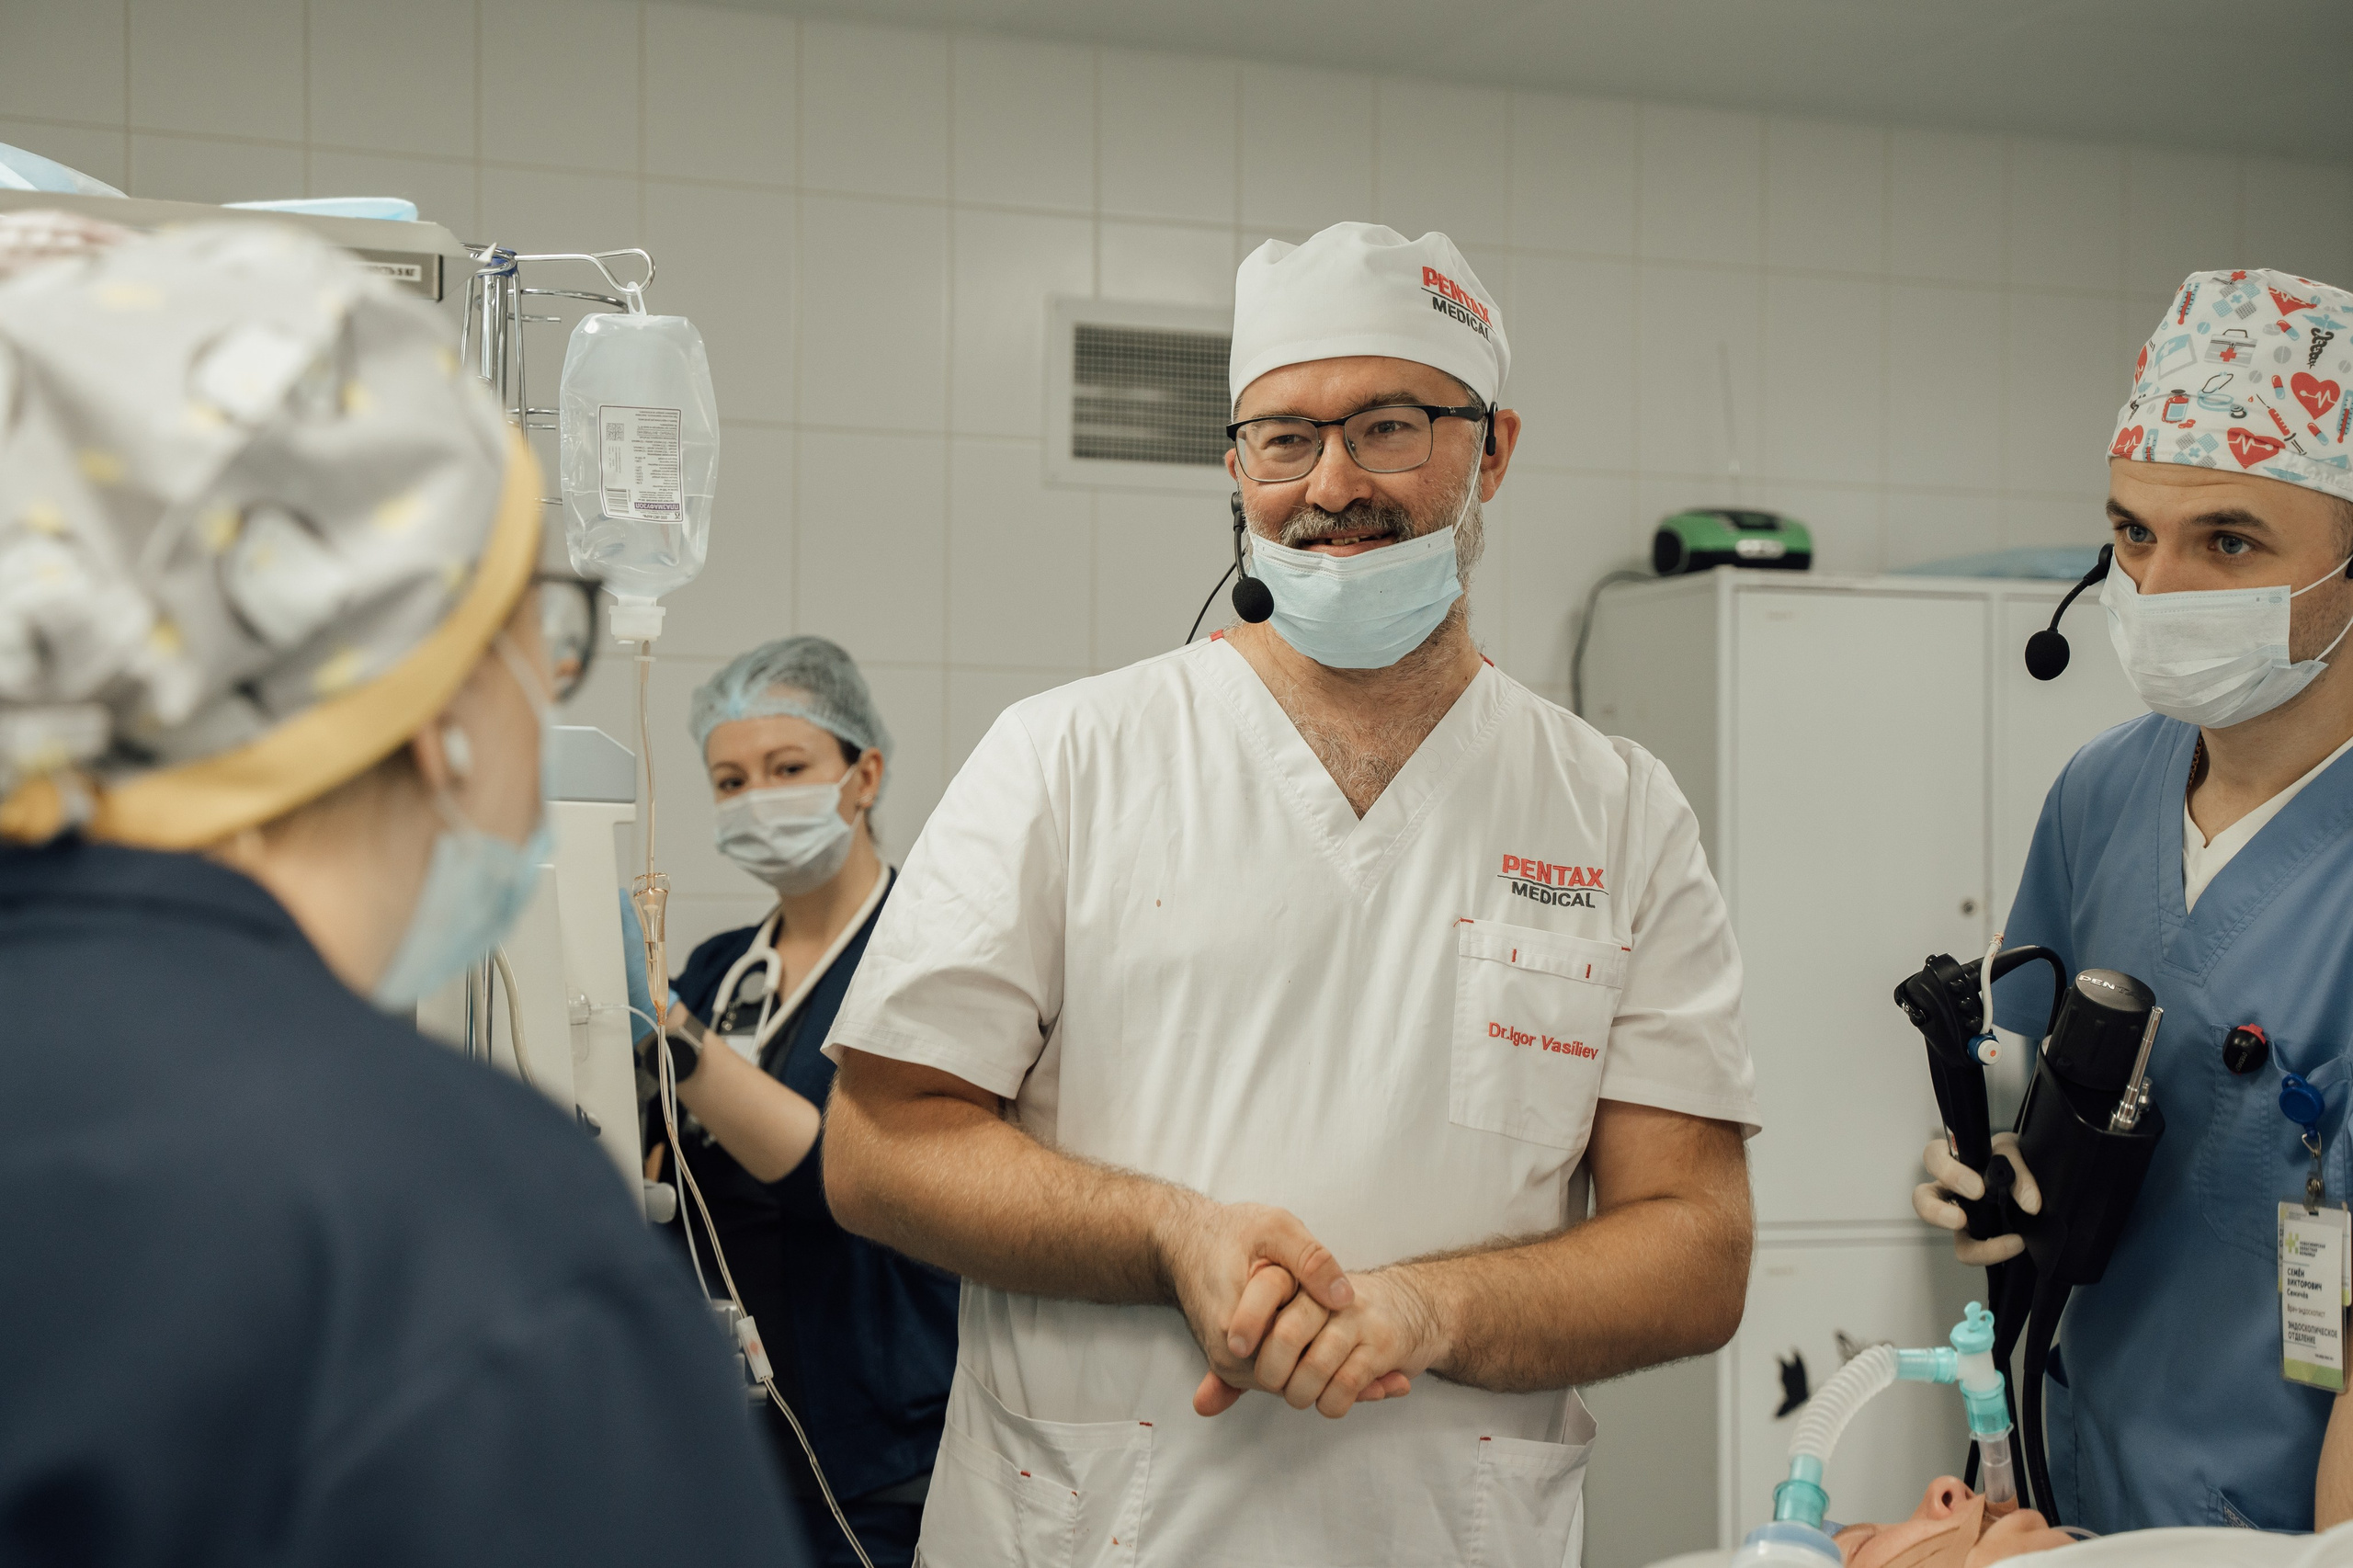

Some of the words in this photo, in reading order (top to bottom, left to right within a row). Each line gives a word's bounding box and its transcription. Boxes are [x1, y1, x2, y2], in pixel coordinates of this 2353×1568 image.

[1422, 266, 1493, 328] PENTAX
[1432, 296, 1492, 344] MEDICAL
[1502, 854, 1605, 890] PENTAX
[1511, 881, 1596, 909] MEDICAL
[1489, 1021, 1536, 1047] Dr.Igor
[1541, 1034, 1598, 1060] Vasiliev
[2287, 1278, 2323, 1291] ВИКТОРОВИЧ
[2288, 1321, 2338, 1339] ЭНДОСКОПИЧЕСКОЕ
[2288, 1331, 2316, 1345] ОТДЕЛЕНИЕ
